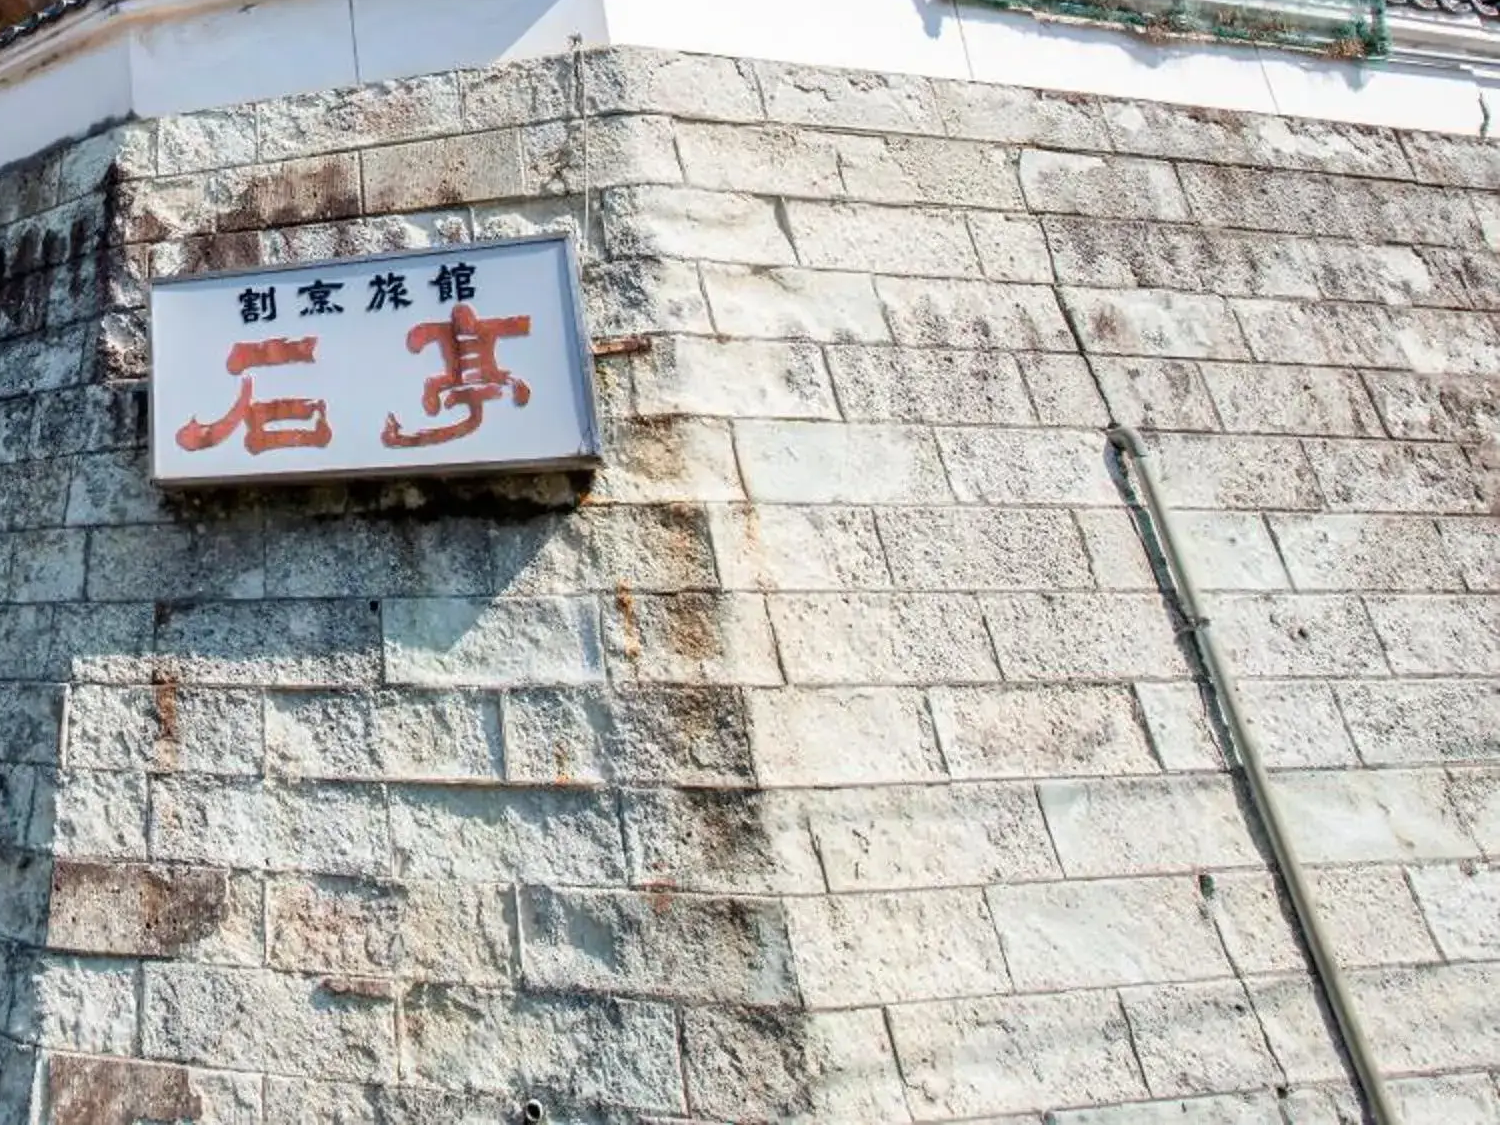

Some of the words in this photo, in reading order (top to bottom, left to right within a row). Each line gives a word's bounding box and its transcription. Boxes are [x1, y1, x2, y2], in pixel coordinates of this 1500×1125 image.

[238, 262, 477, 324] 割烹旅館
[175, 303, 532, 456] 石亭
